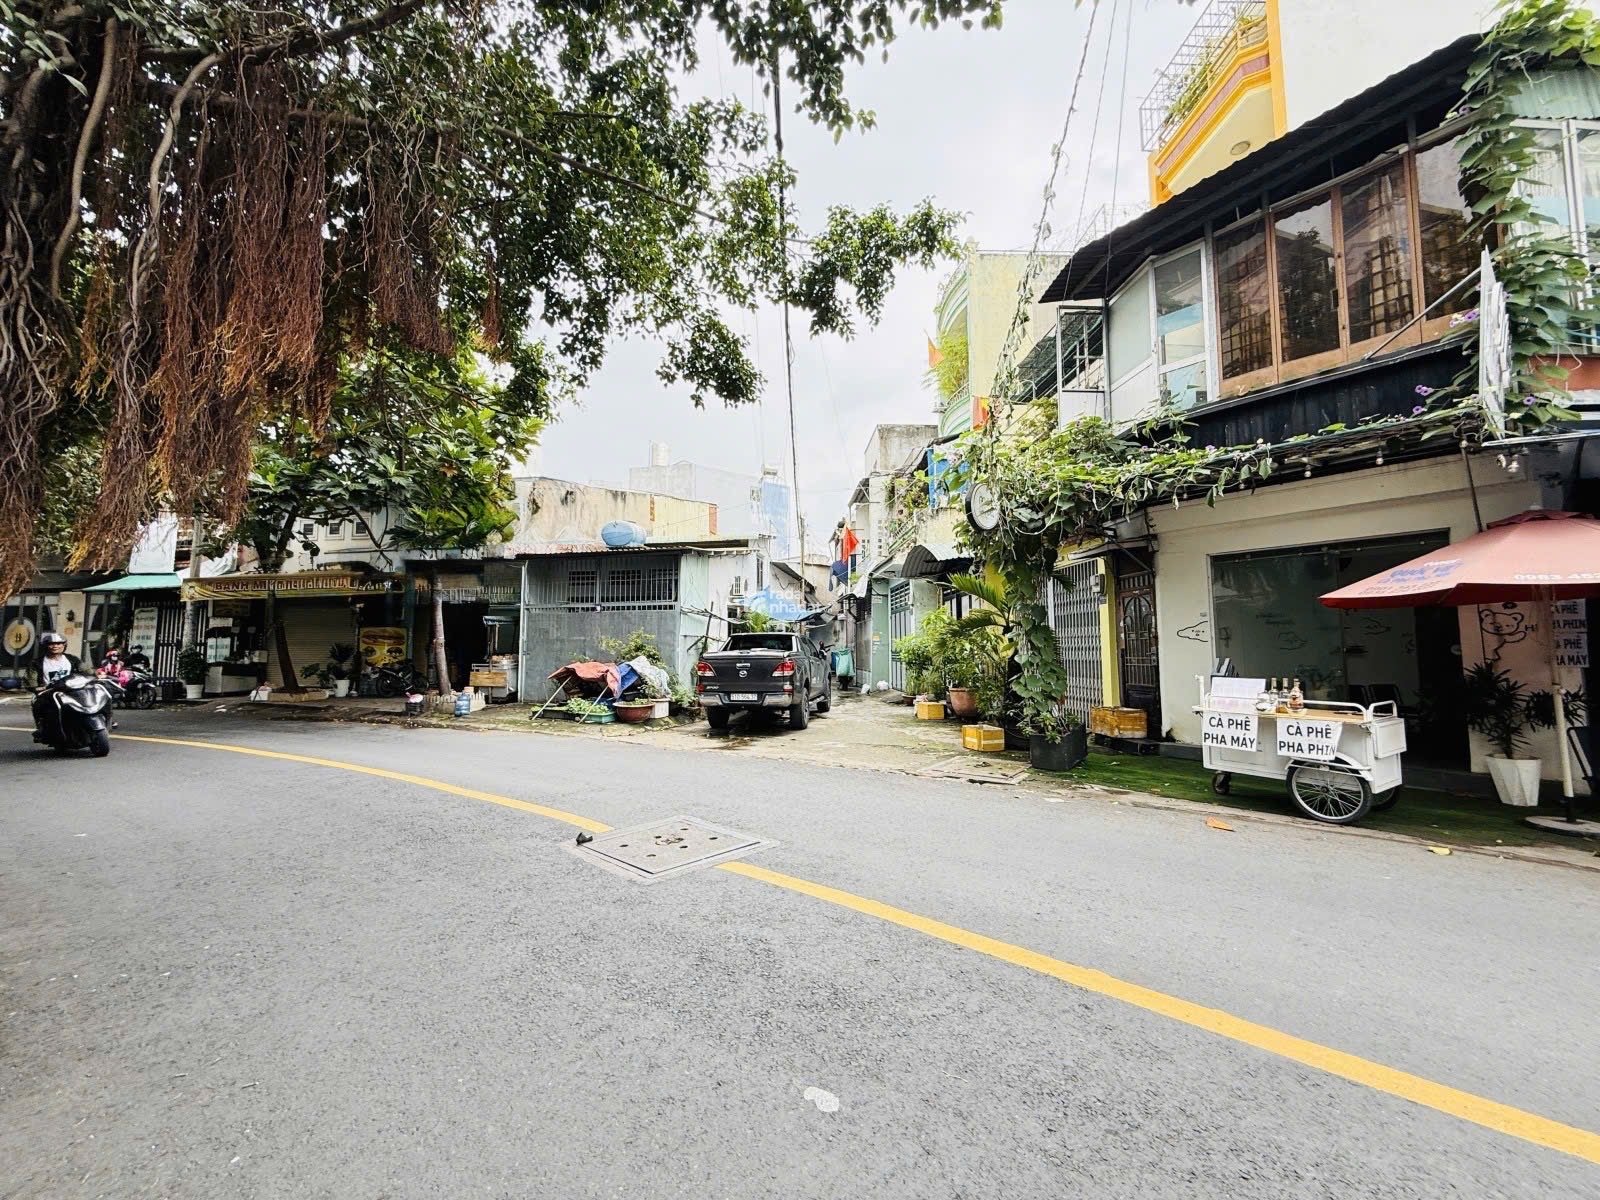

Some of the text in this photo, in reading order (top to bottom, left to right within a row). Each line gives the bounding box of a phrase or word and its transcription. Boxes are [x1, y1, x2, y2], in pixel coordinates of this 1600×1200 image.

[1567, 651, 1587, 666] MÁY
[1208, 713, 1251, 731] CÀ PHÊ
[1286, 722, 1332, 739] CÀ PHÊ
[1203, 732, 1256, 749] PHA MÁY
[1279, 741, 1336, 756] PHA PHIN
